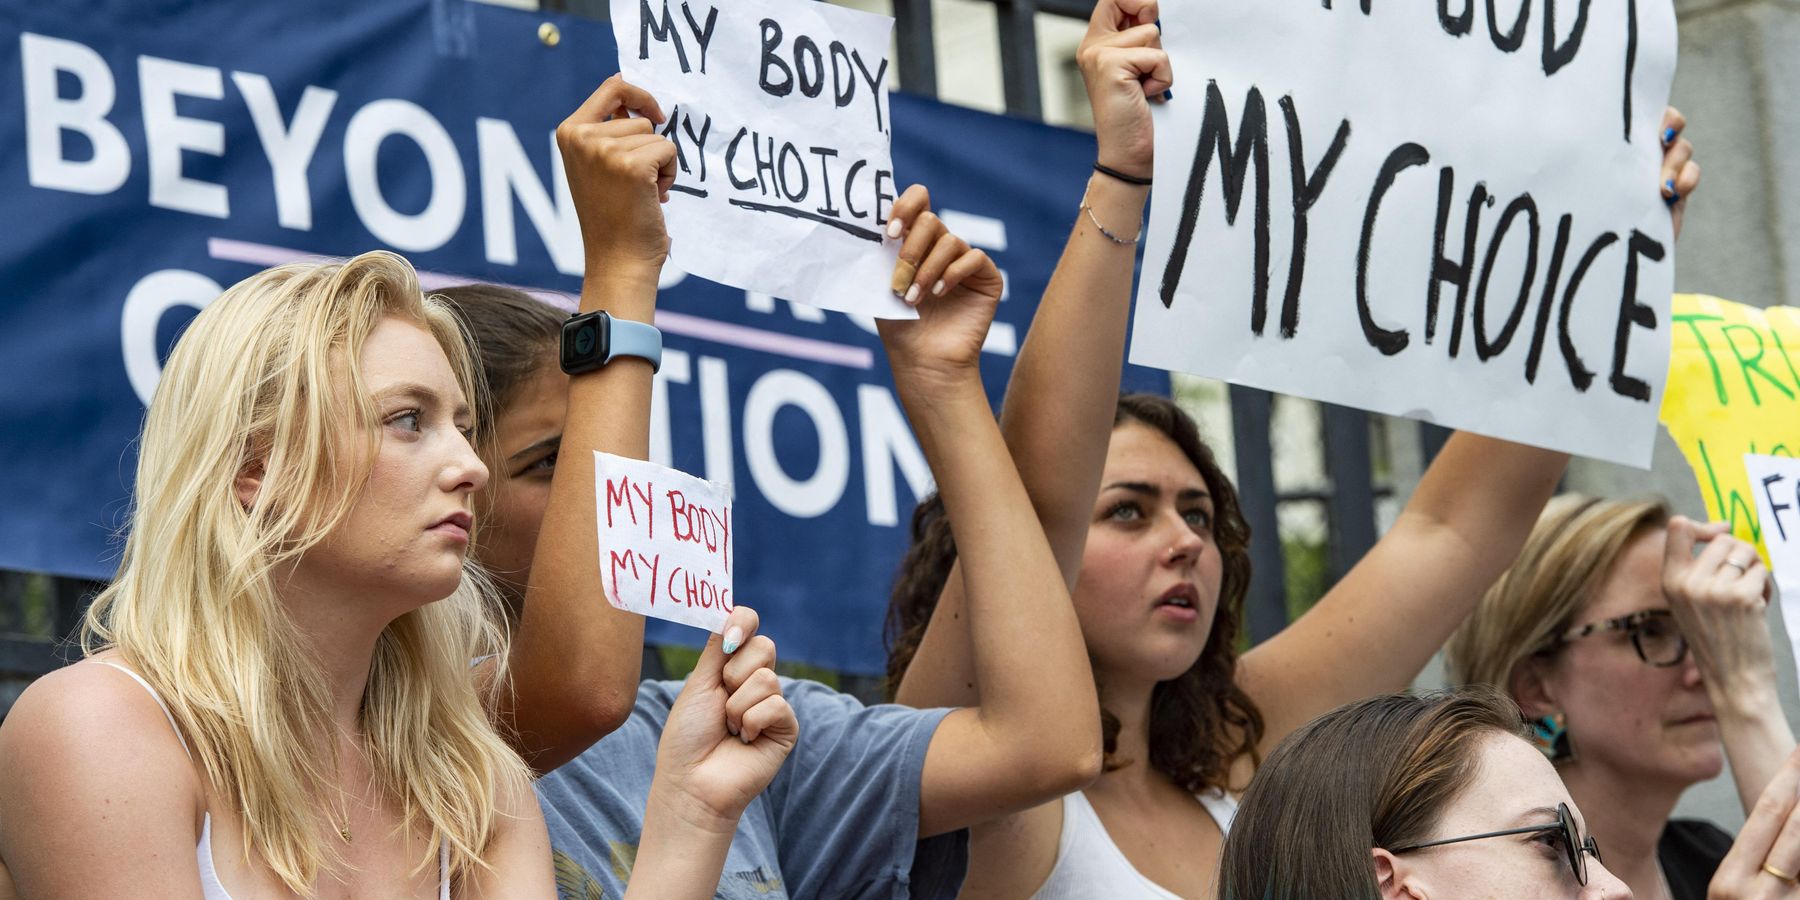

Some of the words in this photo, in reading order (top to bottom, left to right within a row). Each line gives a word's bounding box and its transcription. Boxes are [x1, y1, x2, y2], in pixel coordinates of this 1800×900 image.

[638, 0, 719, 75] MY
[19, 31, 688, 290] BEYON
[724, 126, 894, 225] CHOICE
[1159, 78, 1351, 339] MY
[1356, 142, 1666, 402] CHOICE
[606, 474, 653, 540] MY
[665, 489, 729, 575] BODY
[609, 548, 660, 608] MY
